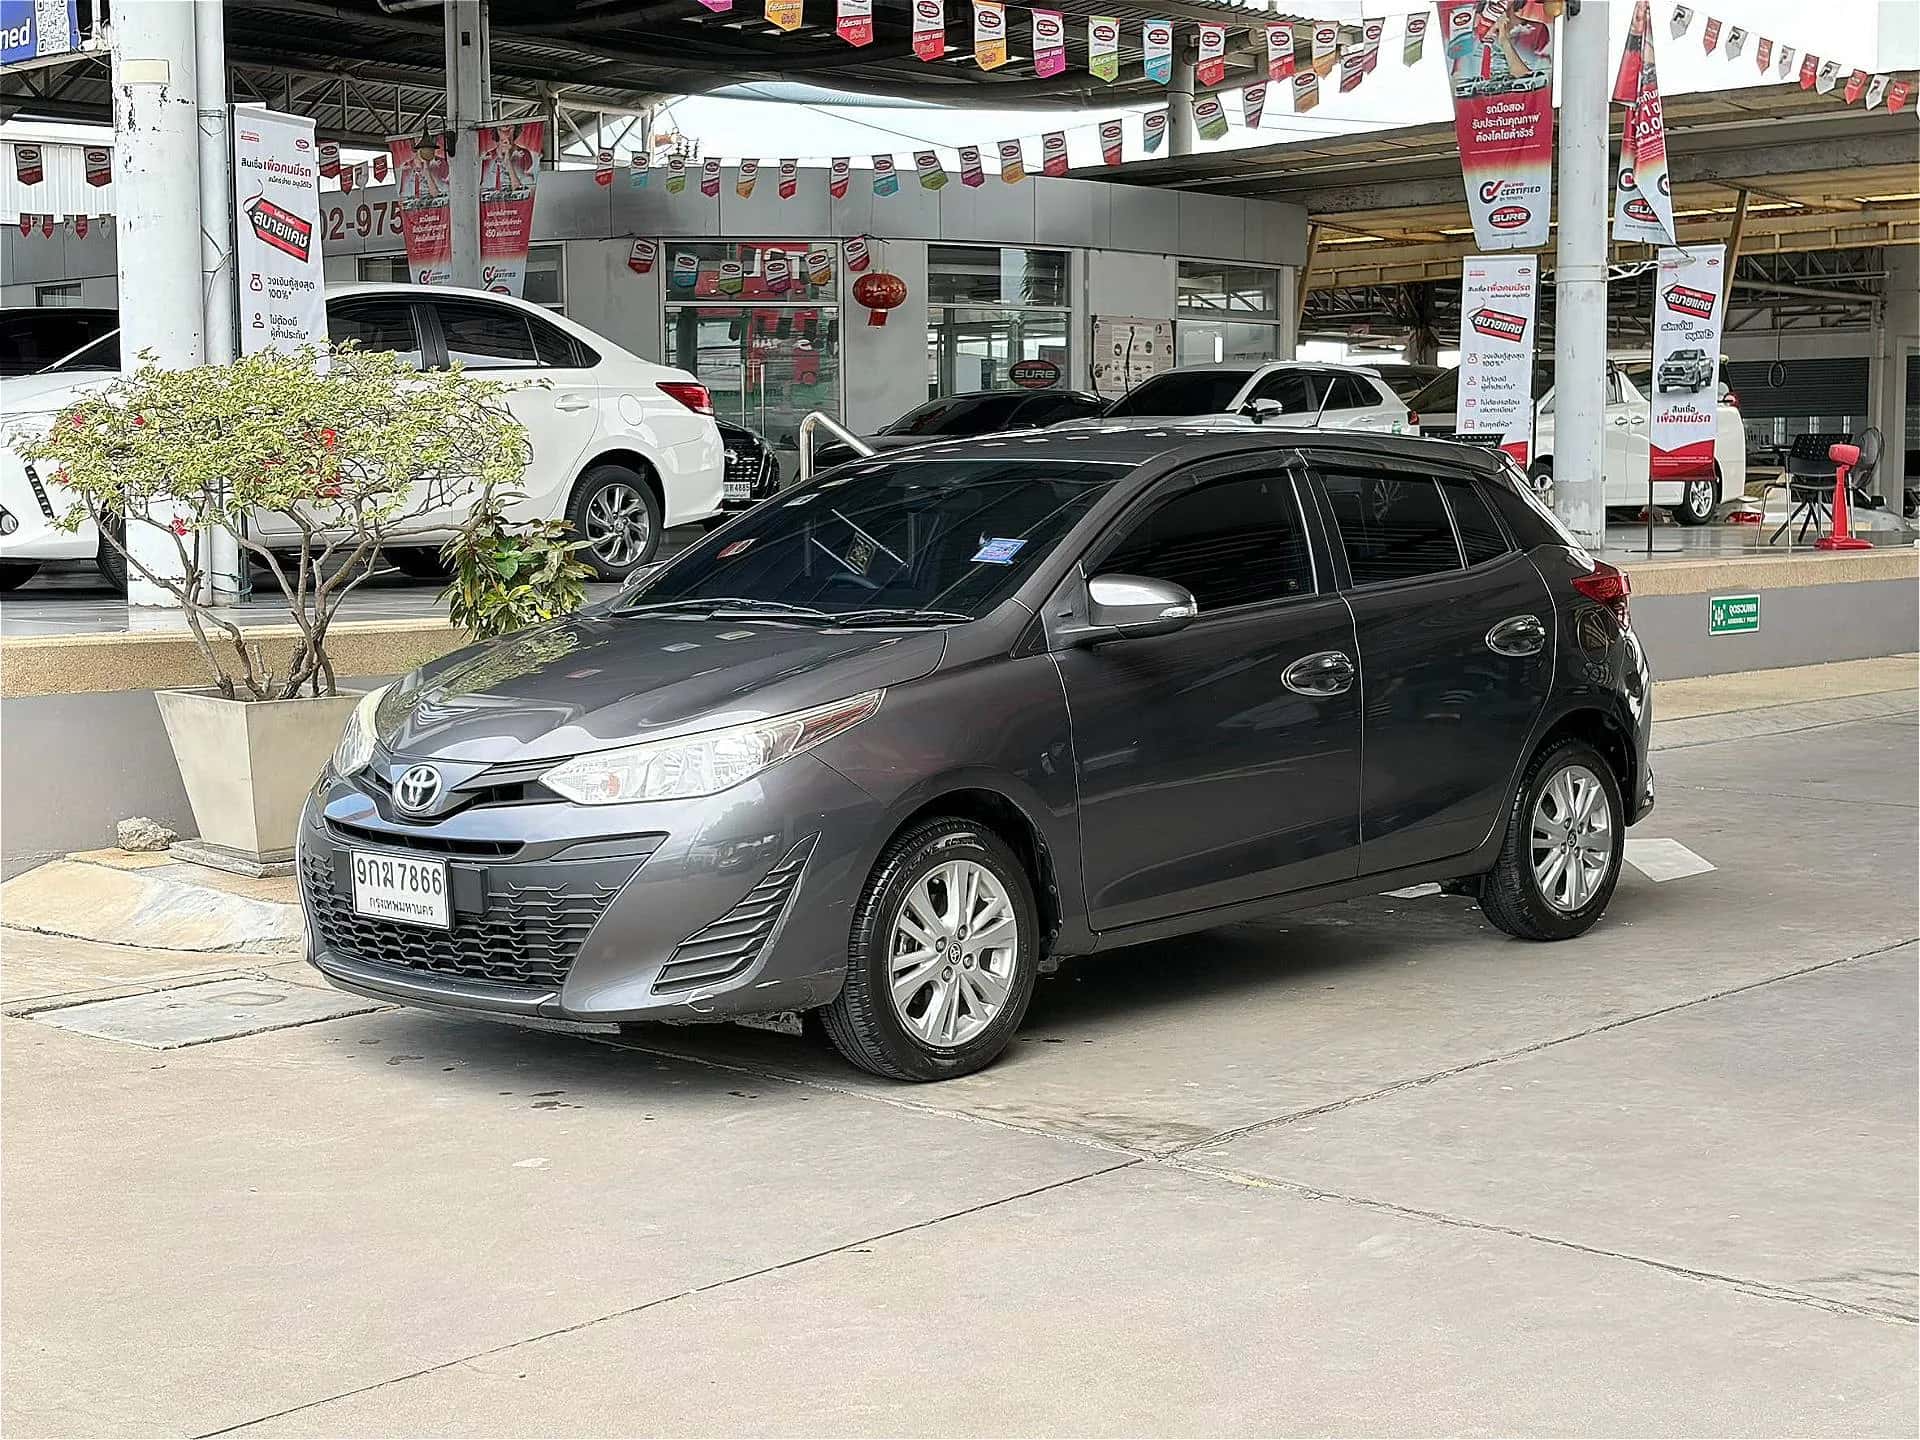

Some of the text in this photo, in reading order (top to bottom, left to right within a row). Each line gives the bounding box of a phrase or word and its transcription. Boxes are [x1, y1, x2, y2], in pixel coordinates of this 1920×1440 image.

[1486, 102, 1525, 114] รถมือสอง
[1500, 185, 1541, 196] CERTIFIED
[1492, 213, 1527, 222] SURE
[254, 211, 309, 248] สบายแคช
[267, 276, 316, 292] วงเงินกู้สูงสุด
[1667, 293, 1713, 311] สบายแคช
[270, 313, 298, 327] ไม่ต้องมี
[1474, 315, 1523, 334] สบายแคช
[1014, 369, 1056, 379] SURE
[1672, 402, 1696, 414] สินเชื่อ
[1656, 410, 1712, 424] เพื่อคนมีรถ
[398, 862, 442, 897] 7866
[369, 896, 434, 917] กรุงเทพมหานคร
